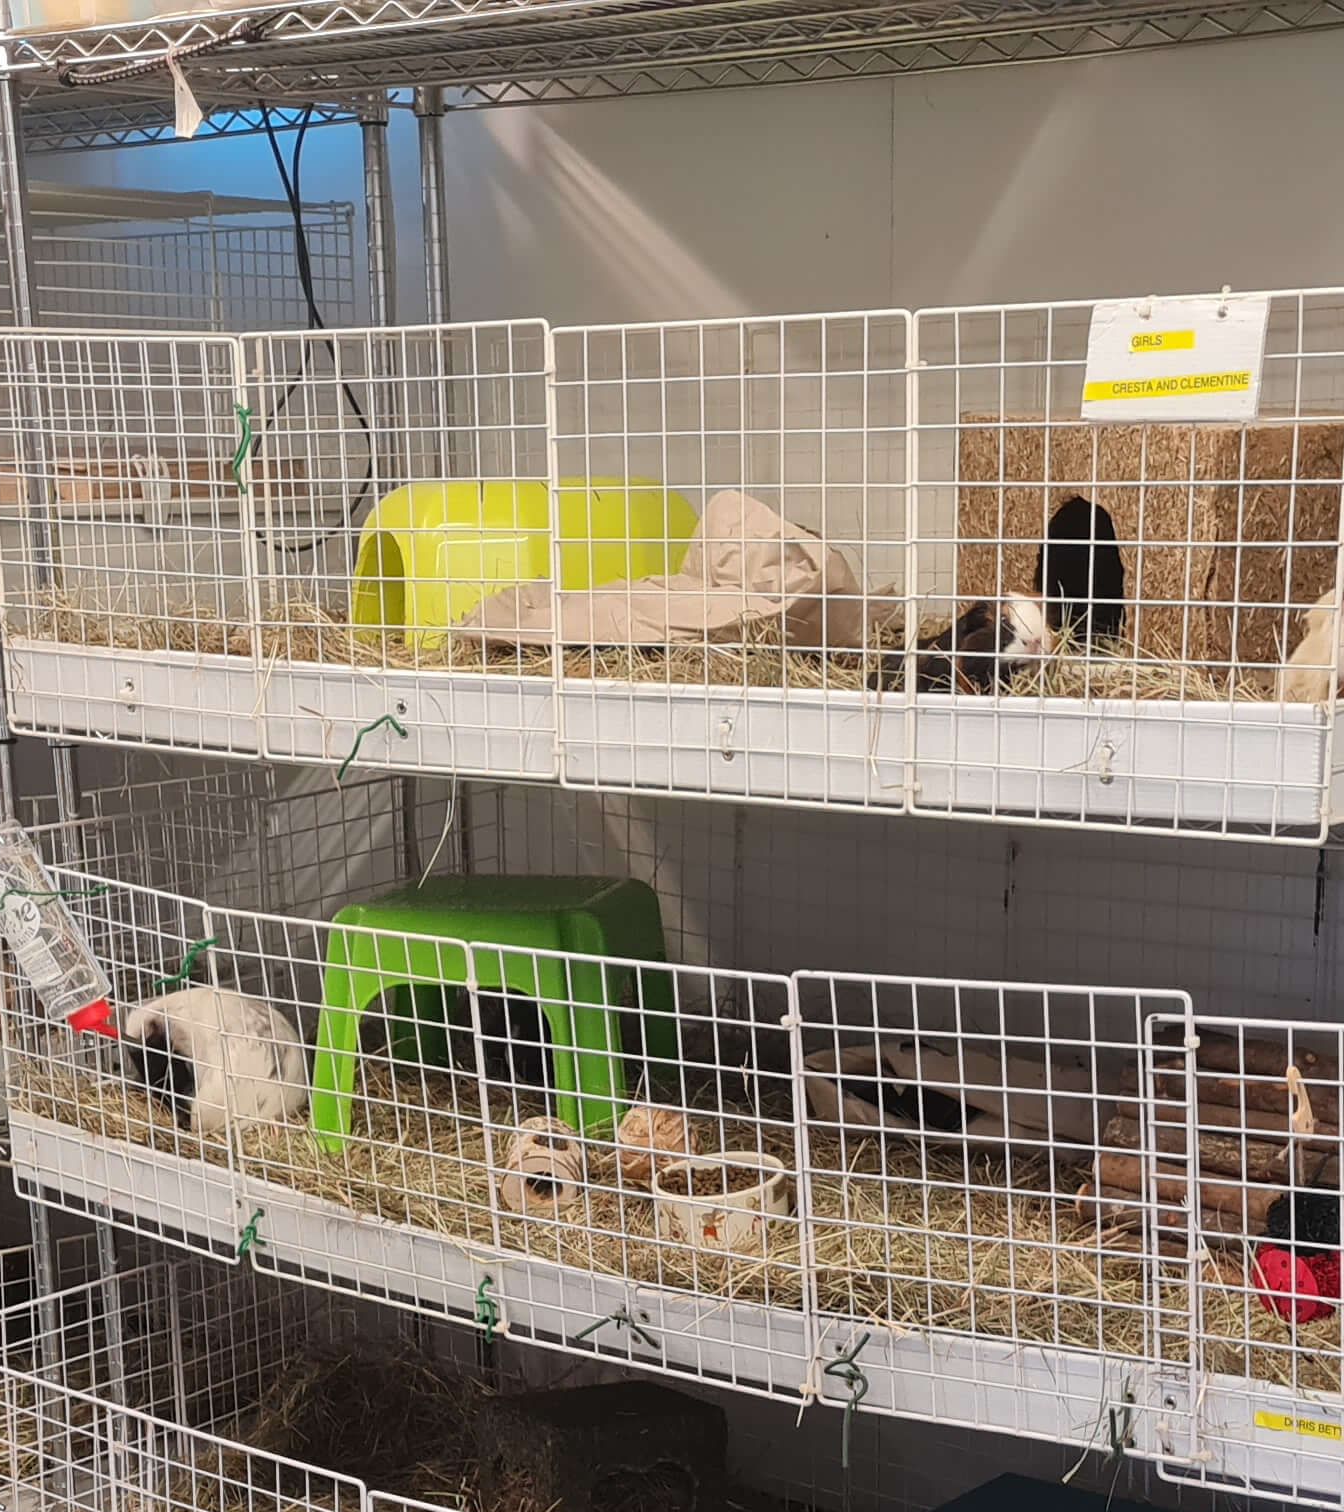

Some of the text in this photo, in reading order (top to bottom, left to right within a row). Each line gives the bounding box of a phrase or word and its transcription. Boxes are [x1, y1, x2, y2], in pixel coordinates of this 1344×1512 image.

[1131, 335, 1163, 347] GIRLS
[1112, 374, 1249, 394] CRESTA AND CLEMENTINE
